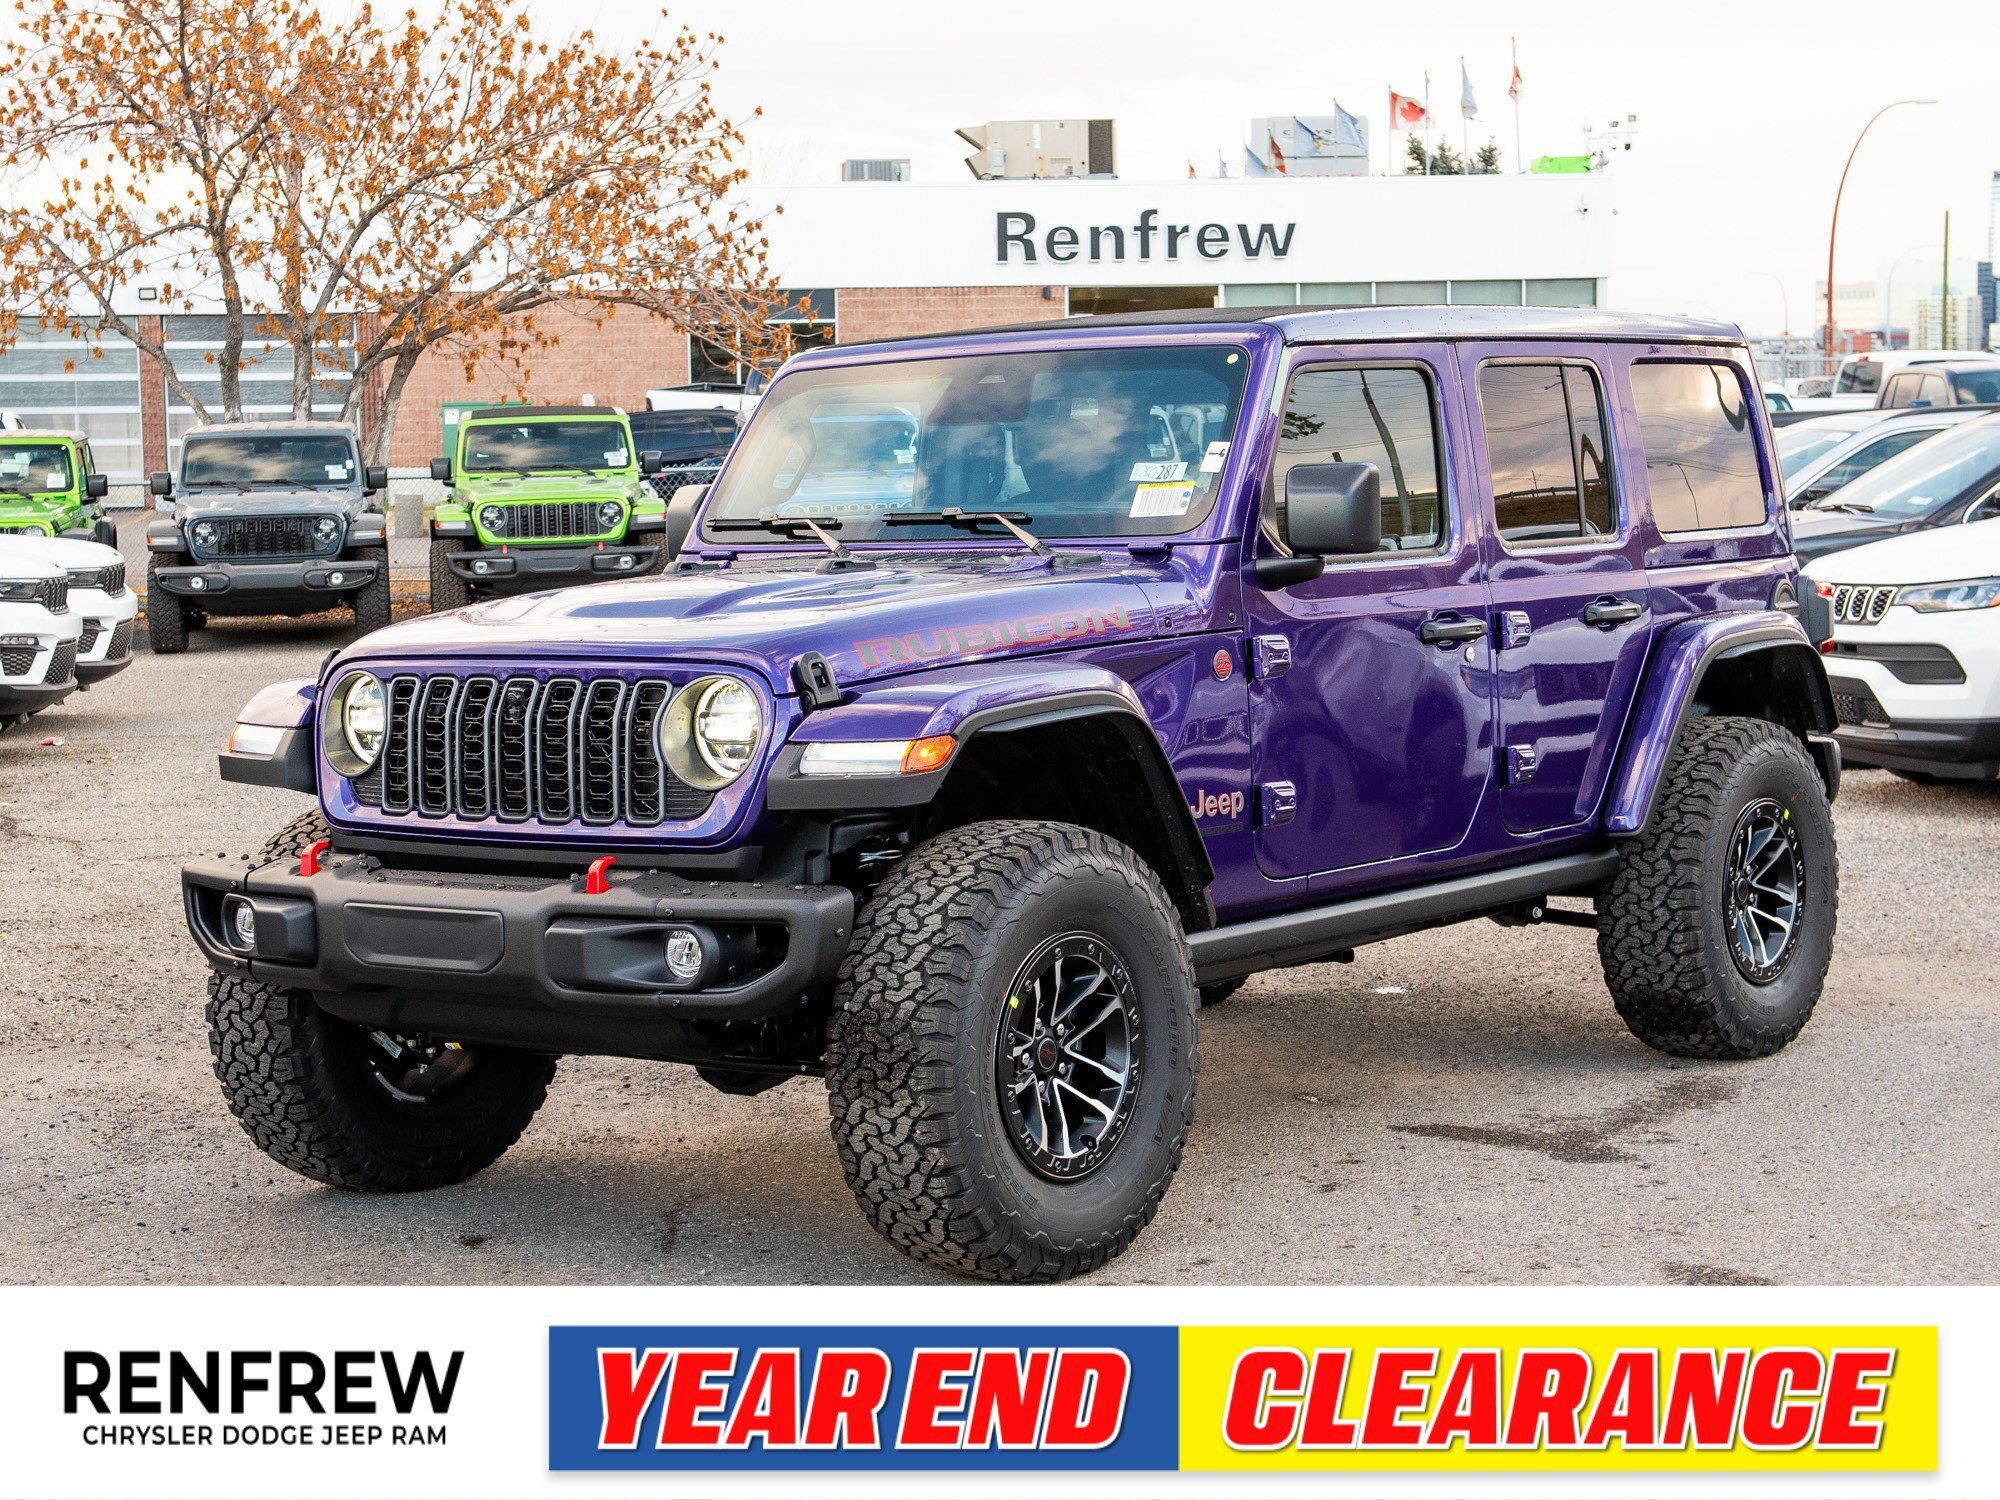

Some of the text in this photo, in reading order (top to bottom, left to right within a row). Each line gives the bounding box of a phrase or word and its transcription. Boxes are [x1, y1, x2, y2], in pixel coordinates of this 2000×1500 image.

[997, 209, 1296, 262] Renfrew
[853, 605, 1133, 669] RUBICON
[1190, 789, 1245, 819] Jeep
